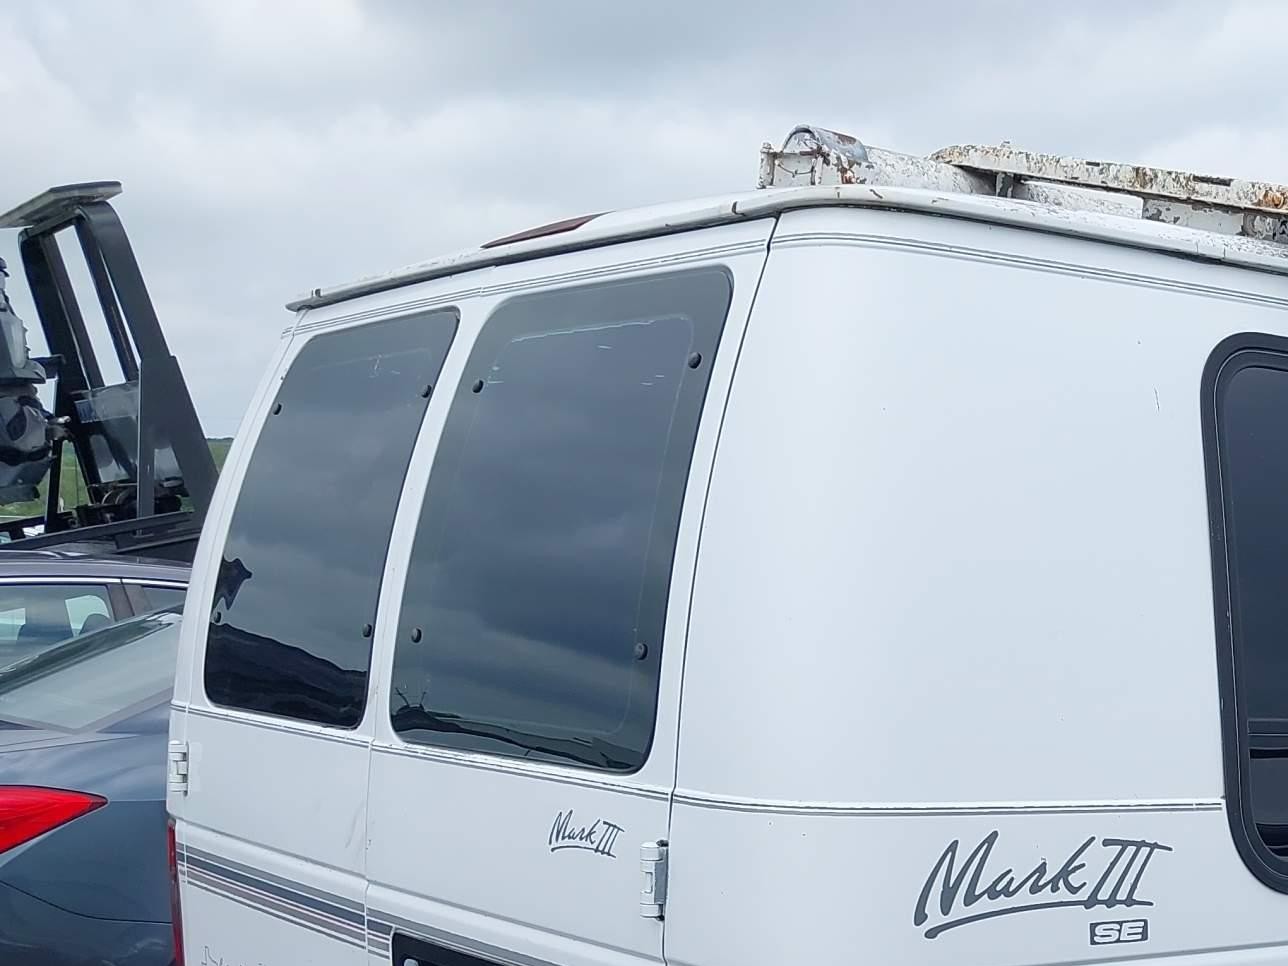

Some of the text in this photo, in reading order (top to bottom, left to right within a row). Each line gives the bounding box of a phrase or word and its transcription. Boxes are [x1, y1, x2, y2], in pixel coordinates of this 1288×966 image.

[548, 809, 625, 856] Mark III
[913, 830, 1174, 926] Mark III
[1093, 922, 1145, 944] SE
